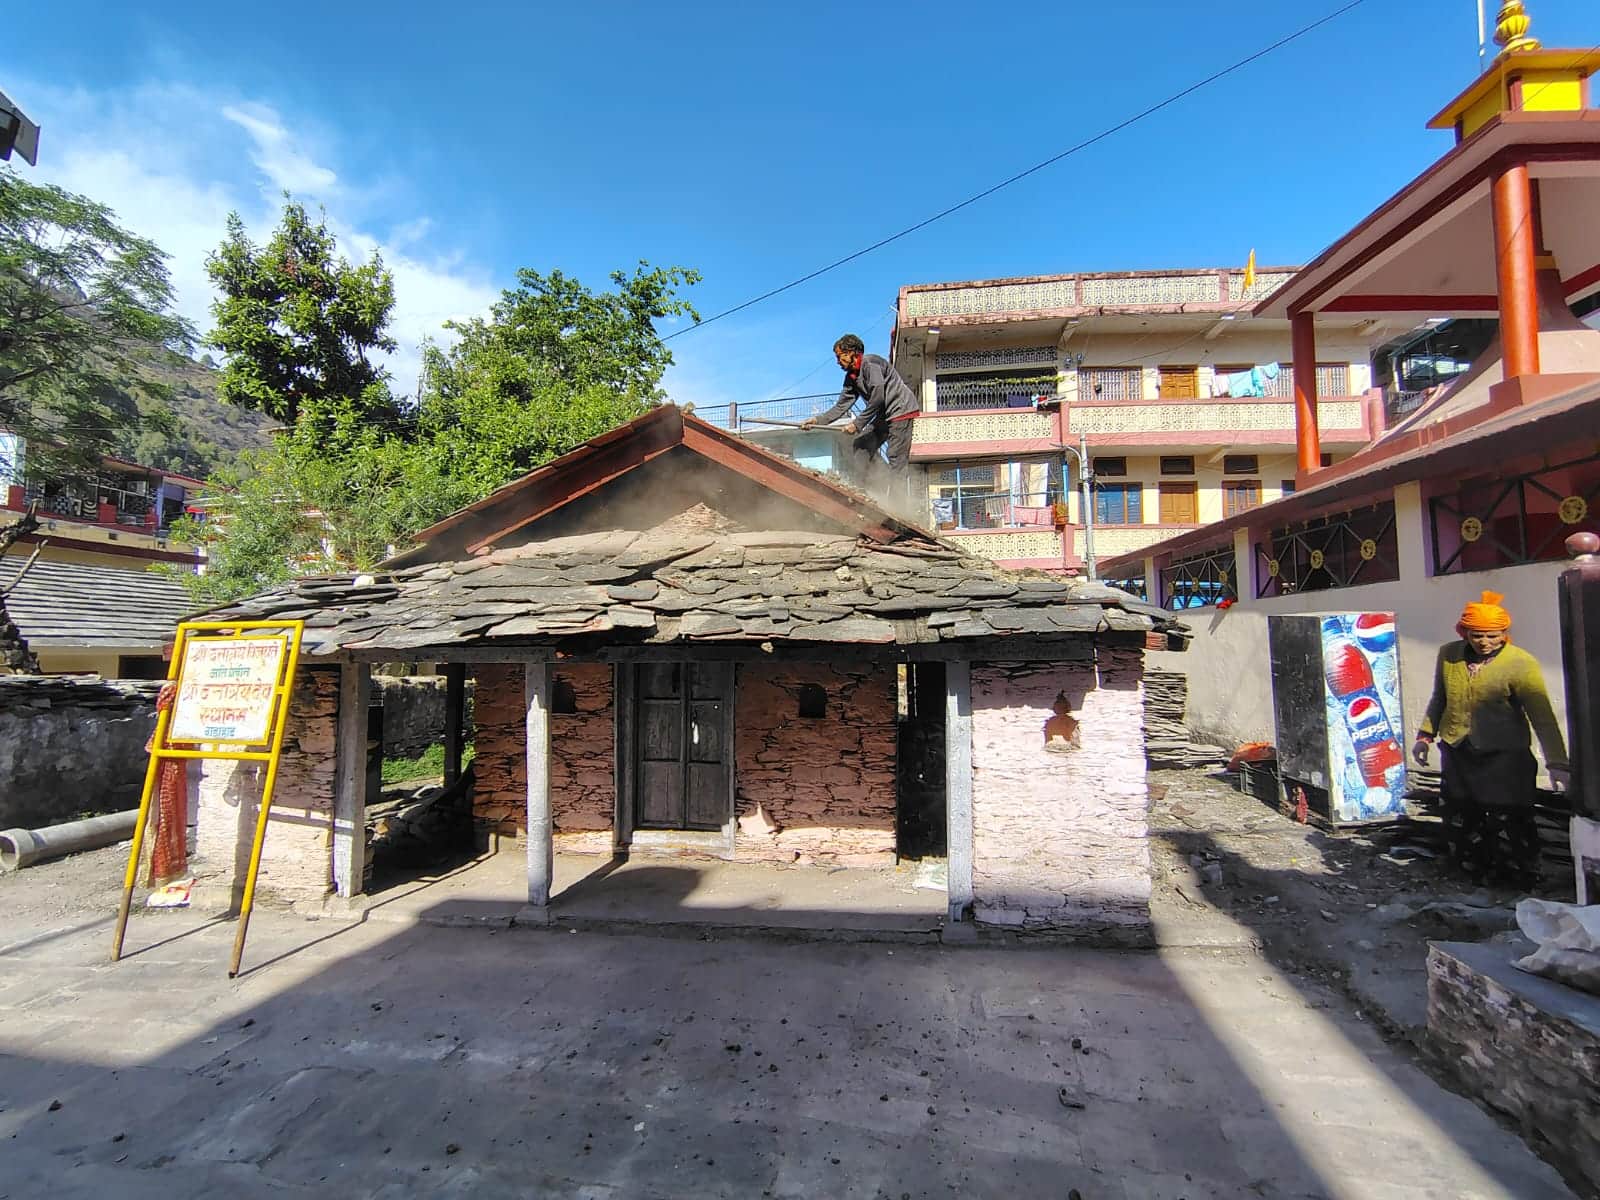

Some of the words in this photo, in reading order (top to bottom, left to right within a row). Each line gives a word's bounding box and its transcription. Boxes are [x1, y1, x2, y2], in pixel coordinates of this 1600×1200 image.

[191, 644, 207, 662] श्री
[183, 678, 200, 701] श्री
[1351, 720, 1388, 741] PEPSI
